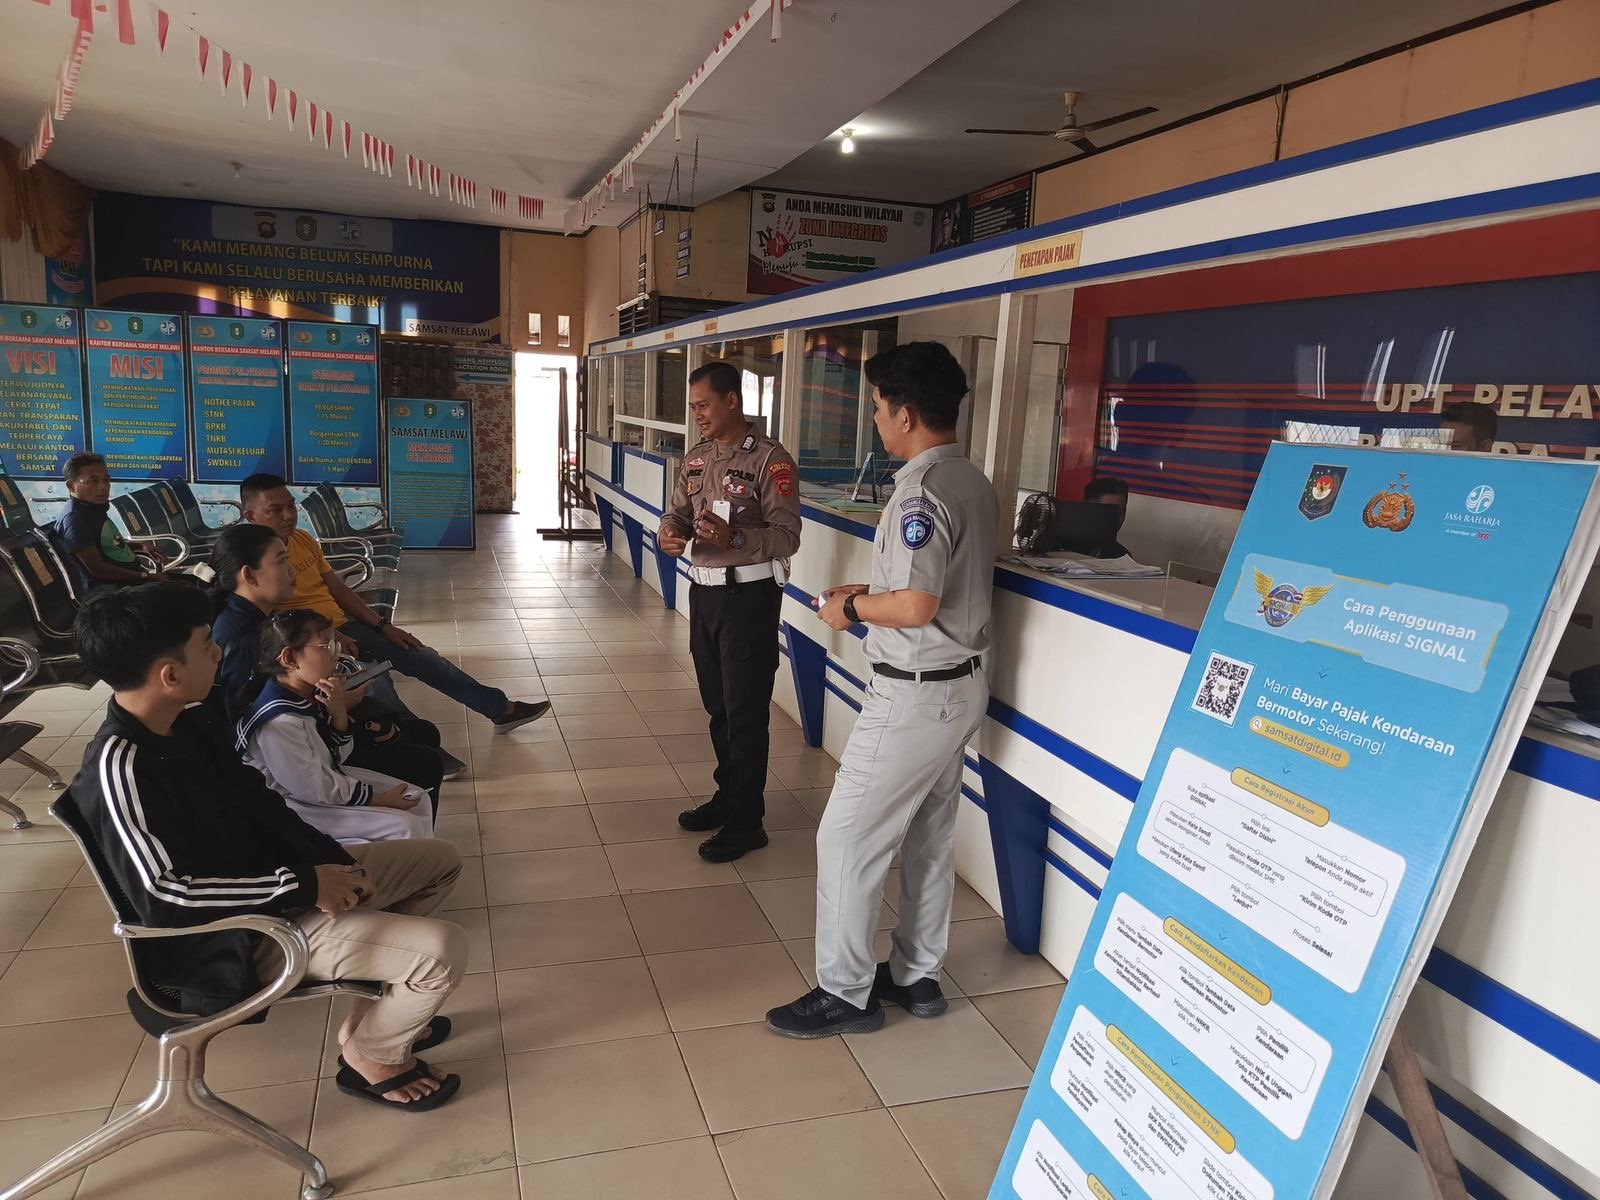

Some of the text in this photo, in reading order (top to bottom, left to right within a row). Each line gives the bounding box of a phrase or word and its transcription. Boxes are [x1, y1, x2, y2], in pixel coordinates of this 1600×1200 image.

[785, 198, 903, 223] ANDA MEMASUKI WILAYAH
[799, 217, 888, 243] ZONA INTEGRITAS
[226, 242, 296, 260] MEMANG
[300, 247, 350, 264] BELUM
[354, 251, 433, 271] SEMPURNA
[1019, 243, 1076, 270] PENETAPAN PAJAK
[142, 257, 464, 294] TAPI KAMI SELALU BERUSAHA MEMBERIKAN
[227, 285, 317, 304] PELAYANAN
[31, 336, 53, 344] SAMSAT
[89, 339, 112, 347] KANTOR
[409, 323, 491, 338] SAMSAT MELAWI
[6, 349, 57, 377] VISI
[110, 354, 164, 380] MISI
[311, 351, 335, 359] BERSAMA
[335, 352, 355, 360] SAMSAT
[355, 353, 375, 361] MELAWI
[0, 380, 65, 389] TERWUJUDNYA
[204, 398, 256, 408] NOTICE PAJAK
[1375, 383, 1453, 414] UPT
[0, 422, 52, 431] AKUNTABEL
[20, 412, 81, 421] TRANSPARAN,
[205, 422, 226, 430] BPKB
[9, 432, 63, 441] TERPERCAYA
[391, 427, 468, 439] SAMSAT MELAWI
[16, 453, 58, 461] BERSAMA
[207, 447, 265, 456] MUTASI KELUAR
[207, 458, 241, 467] SWDKLLJ
[20, 463, 56, 471] SAMSAT
[726, 468, 755, 482] POLRI
[1443, 512, 1501, 528] JASA RAHARJA
[1343, 598, 1476, 641] Cara Penggunaan
[1343, 619, 1466, 663] Aplikasi SIGNAL
[1256, 695, 1386, 755] Bermotor Sekarang!
[1263, 677, 1455, 757] Mari Bayar Pajak Kendaraan
[1264, 725, 1342, 762] samsatdigital.id
[1190, 794, 1207, 808] SIGNAL
[1198, 791, 1216, 804] aplikasi
[1244, 777, 1315, 815] Cara Registrasi Akun
[1187, 821, 1199, 831] Kata
[1198, 826, 1212, 838] Sandi
[1251, 818, 1271, 833] Pilih link
[1158, 849, 1192, 872] yang Anda buat
[1182, 854, 1193, 864] Kata
[1192, 860, 1207, 872] Sandi
[1225, 842, 1285, 882] Masukan Kode OTP yang
[1228, 854, 1276, 885] dikirim melalui SMS
[1316, 853, 1366, 883] Masukkan Nomor
[1304, 856, 1374, 899] Telepon Anda yang aktif
[1230, 884, 1260, 906] Pilih tombol
[1310, 891, 1345, 915] Pilih tombol
[1292, 928, 1334, 958] Proses Selesai
[1169, 923, 1264, 997] Cara Mendaftarkan Kendaraan
[1180, 975, 1229, 1016] Kendaraan Bermotor
[1188, 971, 1205, 988] tombol
[1205, 984, 1224, 1002] Tambah
[1223, 1000, 1236, 1013] Data
[1186, 1018, 1201, 1034] Lanjut
[1255, 1034, 1284, 1061] Kendaraan
[1256, 1025, 1290, 1055] Pilih Pemilik
[1229, 1044, 1293, 1101] Masukkan NIK & Unggah
[1235, 1059, 1281, 1101] Foto KTP Pemilik
[1117, 1037, 1221, 1137] Cara Pendaftaran Pengesahan STNK
[1240, 1073, 1269, 1102] Kendaraan
[1150, 1105, 1188, 1145] Muncul informasi
